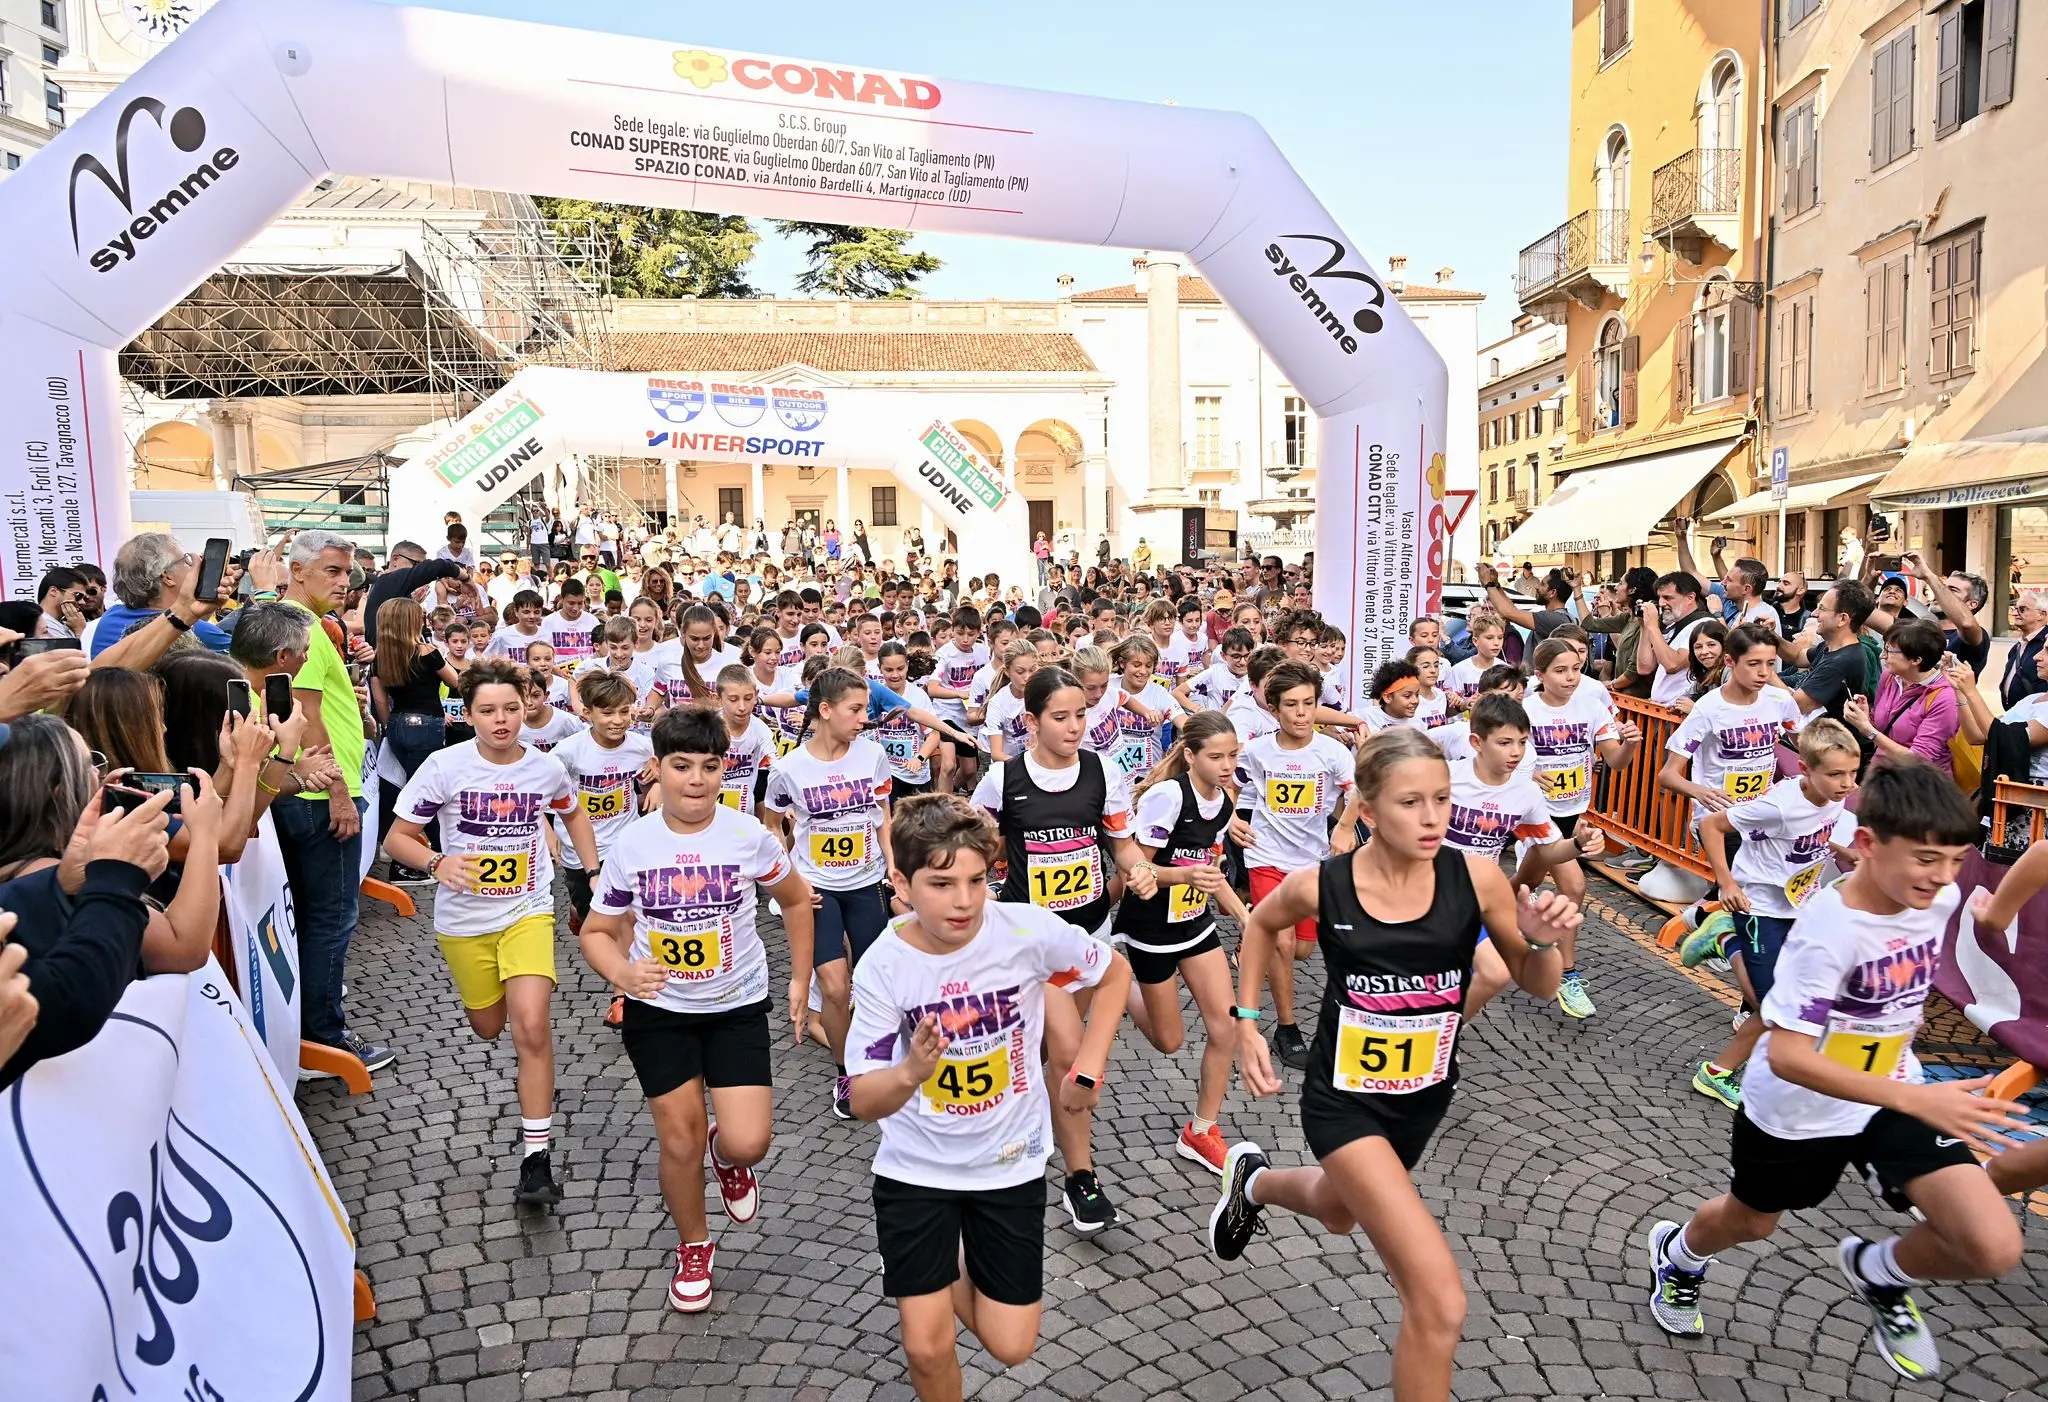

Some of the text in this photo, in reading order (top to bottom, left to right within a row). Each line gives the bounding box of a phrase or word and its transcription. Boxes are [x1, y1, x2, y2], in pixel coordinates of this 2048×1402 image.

[731, 58, 942, 110] CONAD
[778, 113, 847, 137] S.C.S. Group
[613, 115, 996, 171] Sede legale: via Guglielmo Oberdan 60/7, San Vito al Tagliamento (PN)
[570, 130, 1030, 193] CONAD SUPERSTORE, via Guglielmo Oberdan 60/7, San Vito al Tagliamento (PN)
[634, 157, 972, 204] SPAZIO CONAD, via Antonio Bardelli 4, Martignacco (UD)
[90, 147, 239, 273] syemme
[1265, 243, 1358, 355] syemme
[648, 378, 704, 392] MEGA
[661, 391, 693, 401] SPORT
[711, 383, 765, 396] MEGA
[772, 387, 825, 400] MEGA
[728, 397, 751, 405] BIKE
[778, 400, 822, 411] OUTDOOR
[424, 389, 525, 470] SHOP & PLAY
[671, 431, 825, 457] INTERSPORT
[933, 419, 1012, 496] SHOP & PLAY
[46, 376, 83, 552] Nazionale 127, Tavagnacco (UD)
[476, 437, 544, 492] UDINE
[25, 440, 58, 555] Mercanti 3, Forlì (FC)
[918, 460, 974, 515] UDINE
[4, 490, 38, 581] Ipermercati s.r.l.
[1380, 453, 1400, 634] Sede legale: via Vittorio Veneto 37,
[1533, 538, 1600, 554] BAR AMERICANO
[1363, 444, 1383, 675] CONAD CITY, via Vittorio Veneto 37, Udine
[1398, 511, 1415, 635] Vasto Alfredo Francesco
[1425, 504, 1443, 617] CON
[552, 632, 593, 647] UDINE
[1532, 723, 1588, 746] UDINE
[1720, 721, 1778, 749] UDINE
[494, 783, 515, 791] 2024
[827, 774, 846, 783] 2024
[1554, 771, 1577, 790] 41
[1734, 774, 1763, 794] 52
[587, 795, 615, 813] 56
[623, 778, 631, 813] MiniRun
[802, 777, 874, 813] UDINE
[1275, 783, 1306, 803] 37
[1315, 772, 1324, 813] MiniRun
[1481, 801, 1499, 811] 2024
[460, 791, 543, 822] UDINE
[589, 811, 619, 820] CONAD
[1278, 806, 1310, 814] CONAD
[498, 825, 536, 835] CONAD
[1449, 803, 1522, 838] UDINE
[821, 837, 854, 857] 49
[864, 822, 872, 864] MiniRun
[479, 858, 517, 883] 23
[527, 839, 537, 892] MiniRun
[675, 853, 701, 864] 2024
[824, 859, 859, 868] CONAD
[637, 865, 741, 907] UDINE
[1034, 865, 1089, 897] 122
[1091, 847, 1101, 899] MiniRun
[1791, 869, 1815, 893] 58
[480, 885, 522, 896] CONAD
[1048, 894, 1088, 909] CONAD
[687, 903, 738, 919] CONAD
[656, 921, 683, 932] MARATONINA
[699, 921, 704, 931] DI
[705, 919, 718, 930] UDINE
[661, 938, 705, 966] 38
[721, 915, 733, 974] MiniRun
[668, 968, 715, 980] CONAD
[1847, 936, 1937, 1000] UDINE
[939, 981, 970, 997] 2024
[1359, 1014, 1442, 1029] MARATONINA DI UDINE
[984, 1043, 991, 1053] DI
[991, 1033, 1007, 1048] UDINE
[1359, 1036, 1414, 1073] 51
[1432, 1012, 1457, 1082] MiniRun
[1860, 1041, 1881, 1072] 1
[1010, 1027, 1029, 1095] MiniRun
[937, 1062, 993, 1099] 45
[1362, 1076, 1424, 1091] CONAD
[945, 1092, 1005, 1116] CONAD
